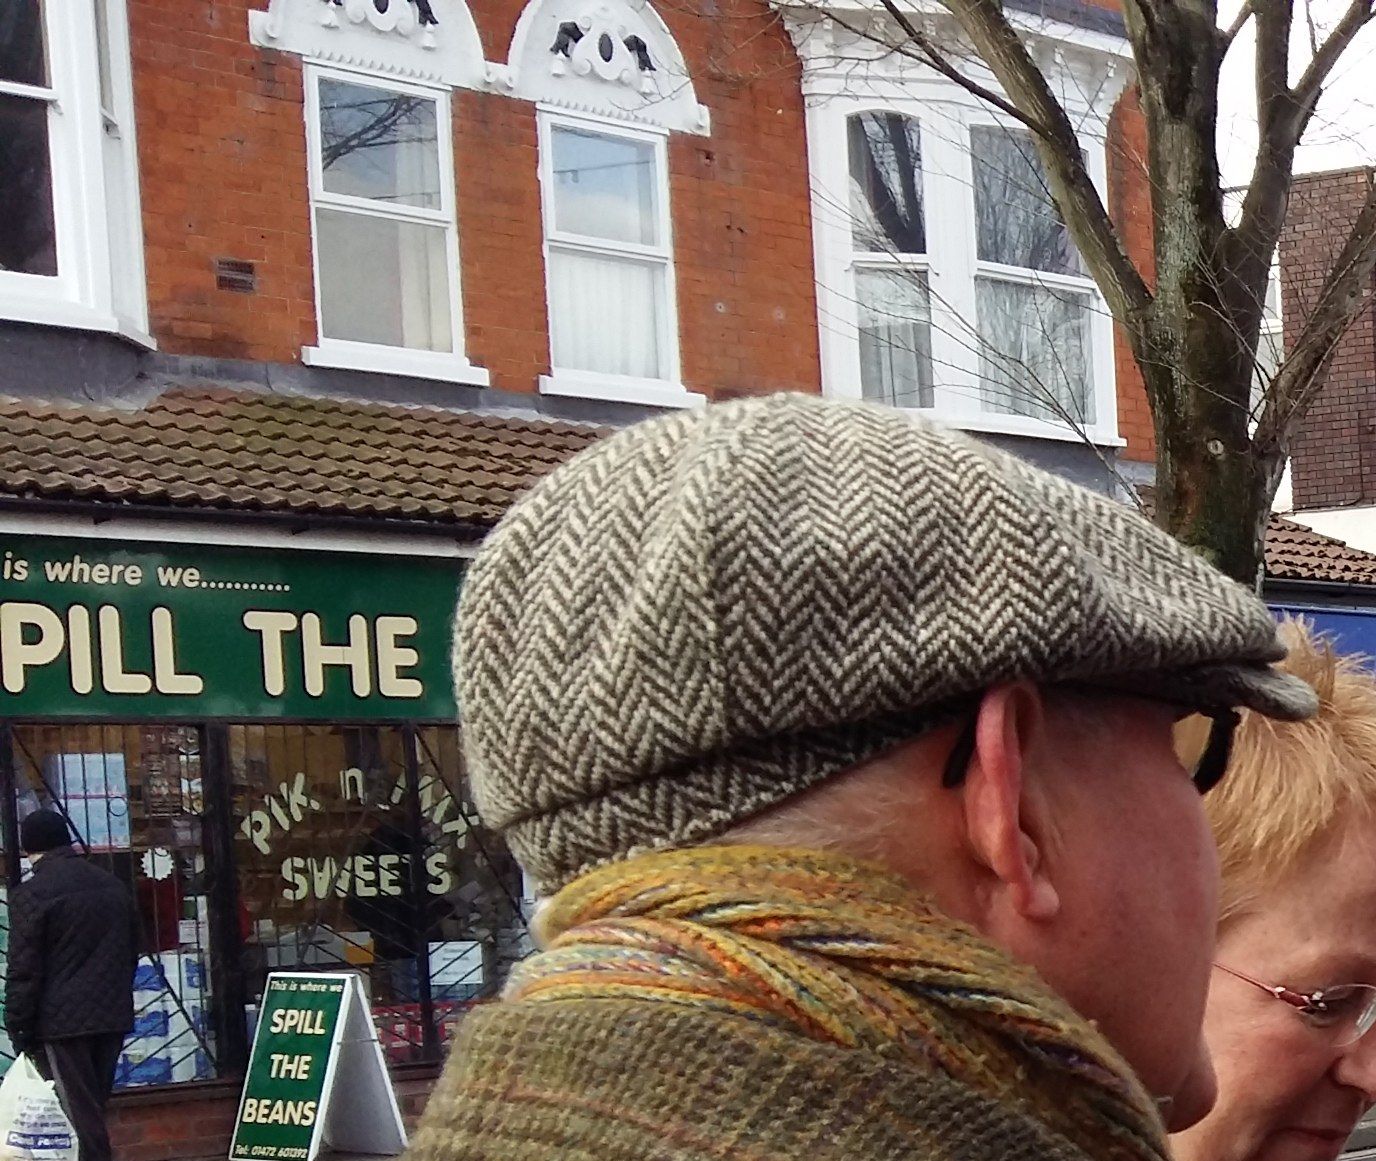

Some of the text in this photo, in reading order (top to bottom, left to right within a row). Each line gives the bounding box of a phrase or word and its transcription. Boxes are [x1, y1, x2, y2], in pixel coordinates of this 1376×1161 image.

[3, 551, 29, 581] is
[44, 555, 142, 586] where
[0, 601, 424, 698] PILL THE
[270, 980, 343, 992] This is where we
[269, 1008, 326, 1035] SPILL
[270, 1053, 312, 1080] THE
[241, 1098, 316, 1127] BEANS
[251, 1145, 277, 1157] 01472
